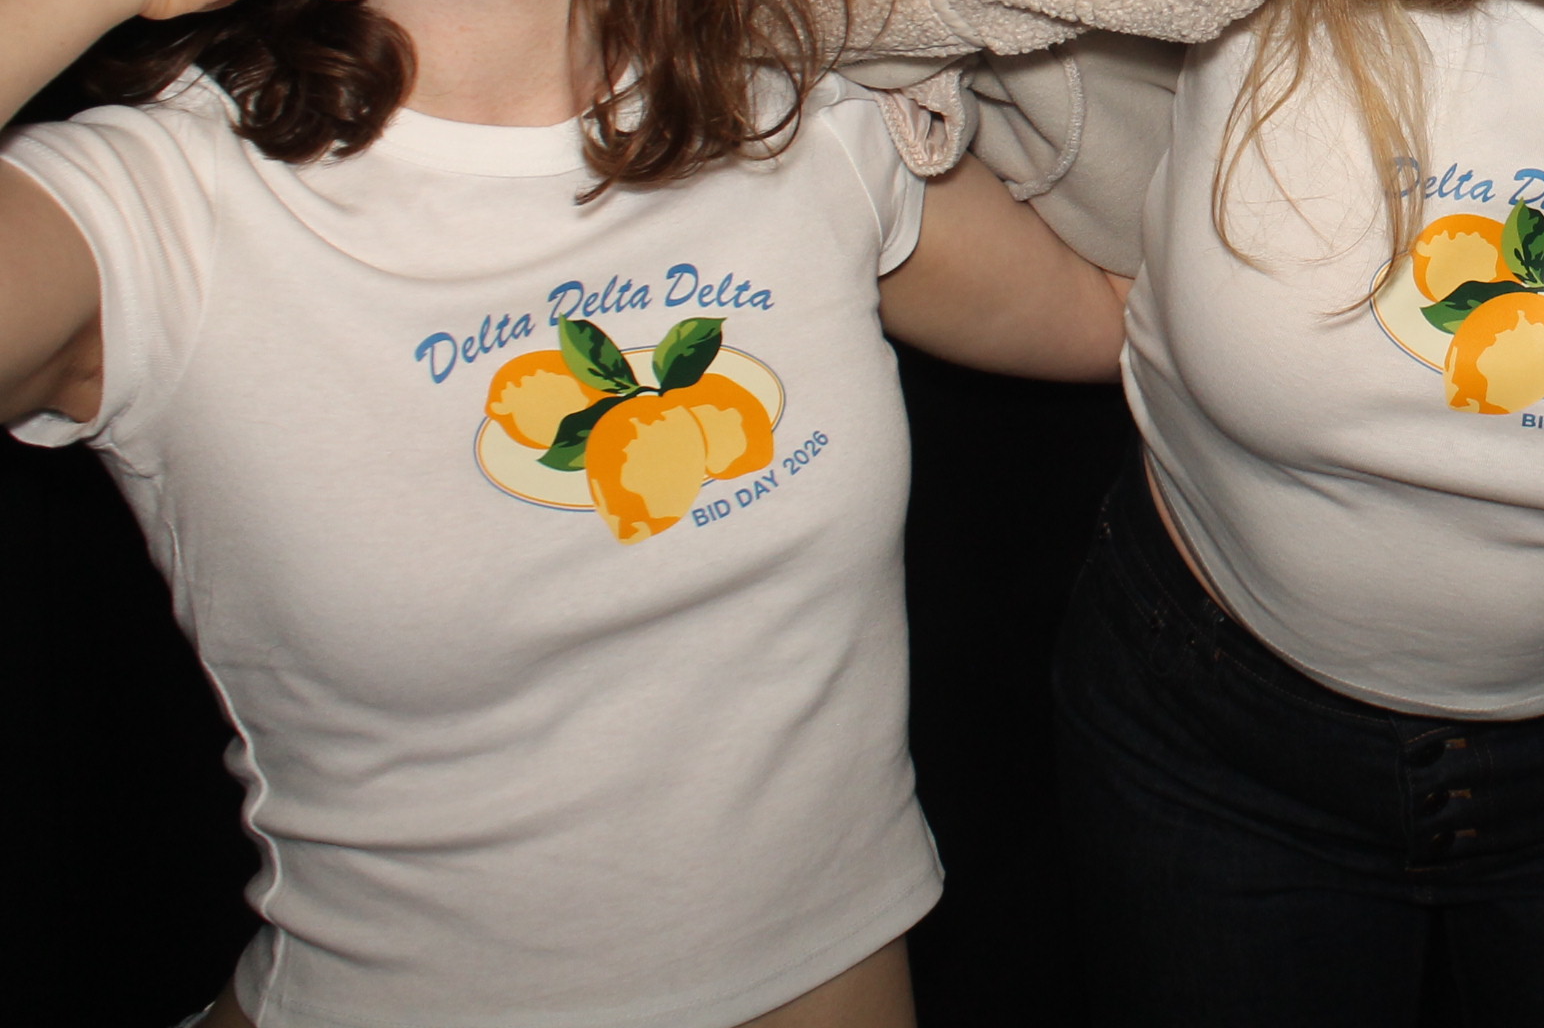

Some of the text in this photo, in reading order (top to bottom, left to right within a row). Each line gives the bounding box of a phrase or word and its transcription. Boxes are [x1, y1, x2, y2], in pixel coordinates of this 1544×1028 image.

[415, 263, 775, 384] Delta Delta Delta
[692, 429, 829, 528] BID DAY 2026
